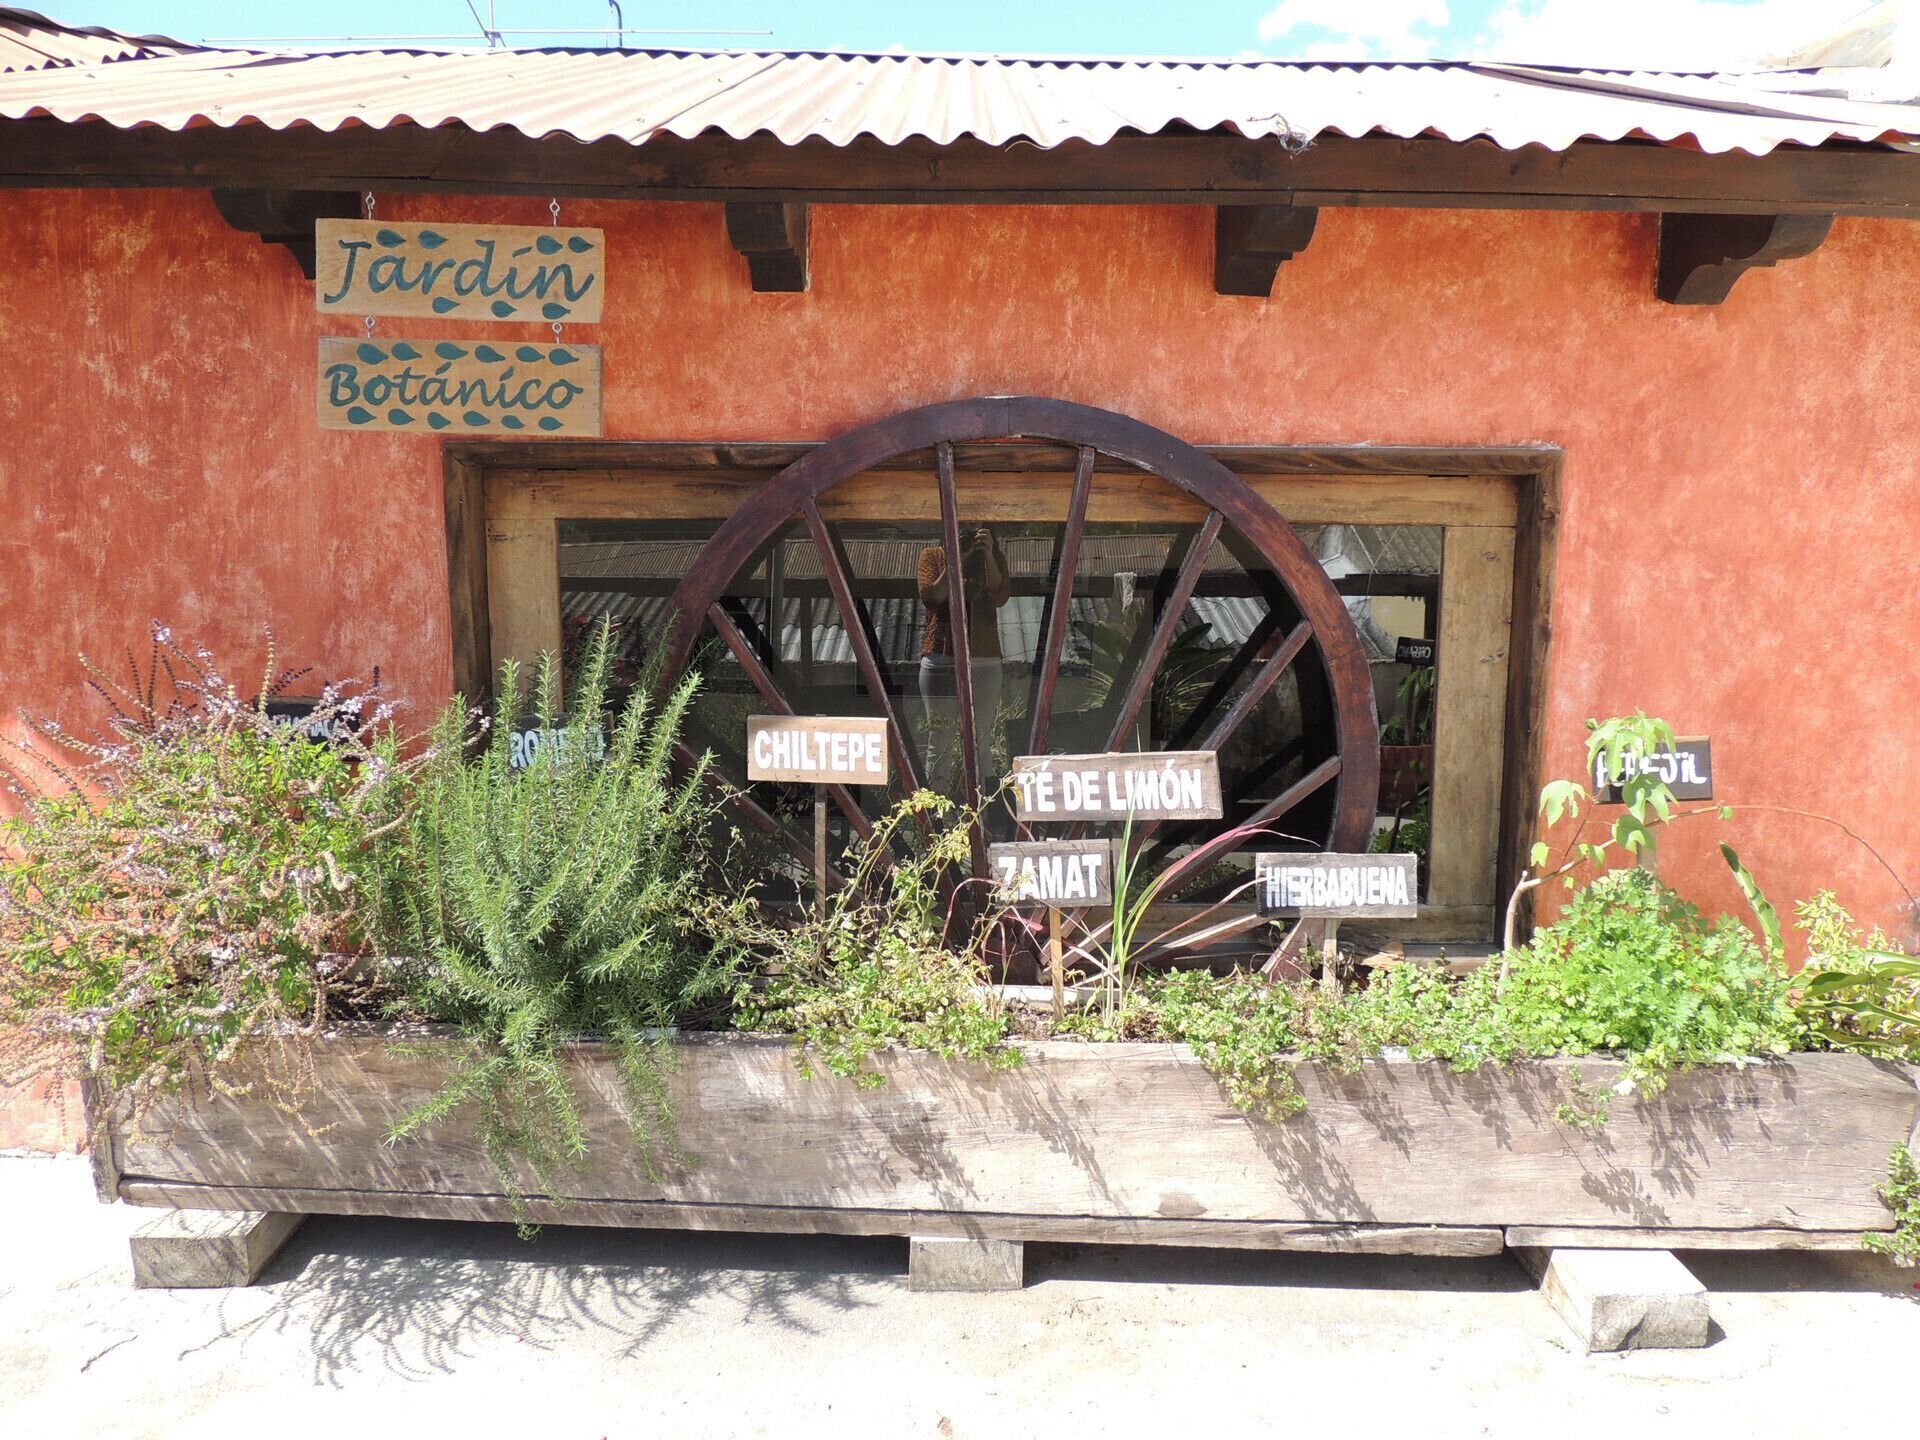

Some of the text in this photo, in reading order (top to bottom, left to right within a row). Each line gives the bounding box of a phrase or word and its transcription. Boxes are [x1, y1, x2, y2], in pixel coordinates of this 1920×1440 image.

[323, 239, 595, 304] Jardín
[754, 730, 882, 772] CHILTEPE
[1017, 758, 1204, 813] TÉ DE LIMÓN
[998, 853, 1102, 901] ZAMAT
[1265, 865, 1409, 908] HIERBABUENA
